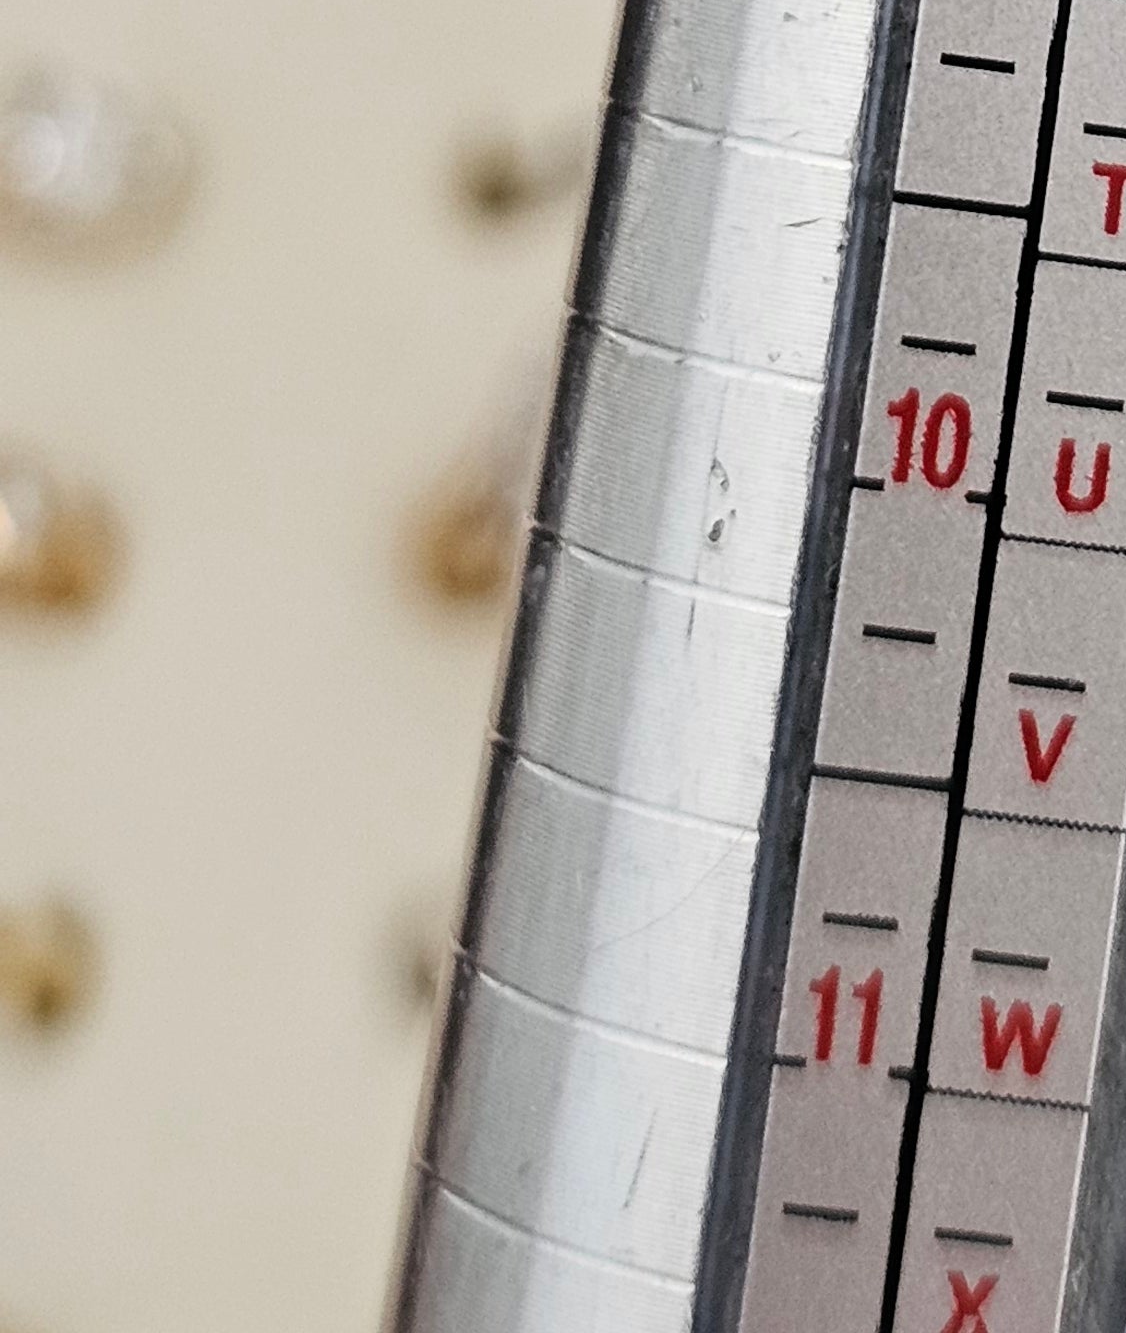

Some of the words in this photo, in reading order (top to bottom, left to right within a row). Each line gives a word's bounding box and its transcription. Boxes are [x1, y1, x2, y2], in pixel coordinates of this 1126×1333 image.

[888, 391, 970, 490] 10
[1055, 440, 1110, 515] U
[1020, 711, 1073, 785] V
[812, 969, 882, 1067] 11
[982, 1003, 1059, 1077] W
[943, 1275, 993, 1333] X
